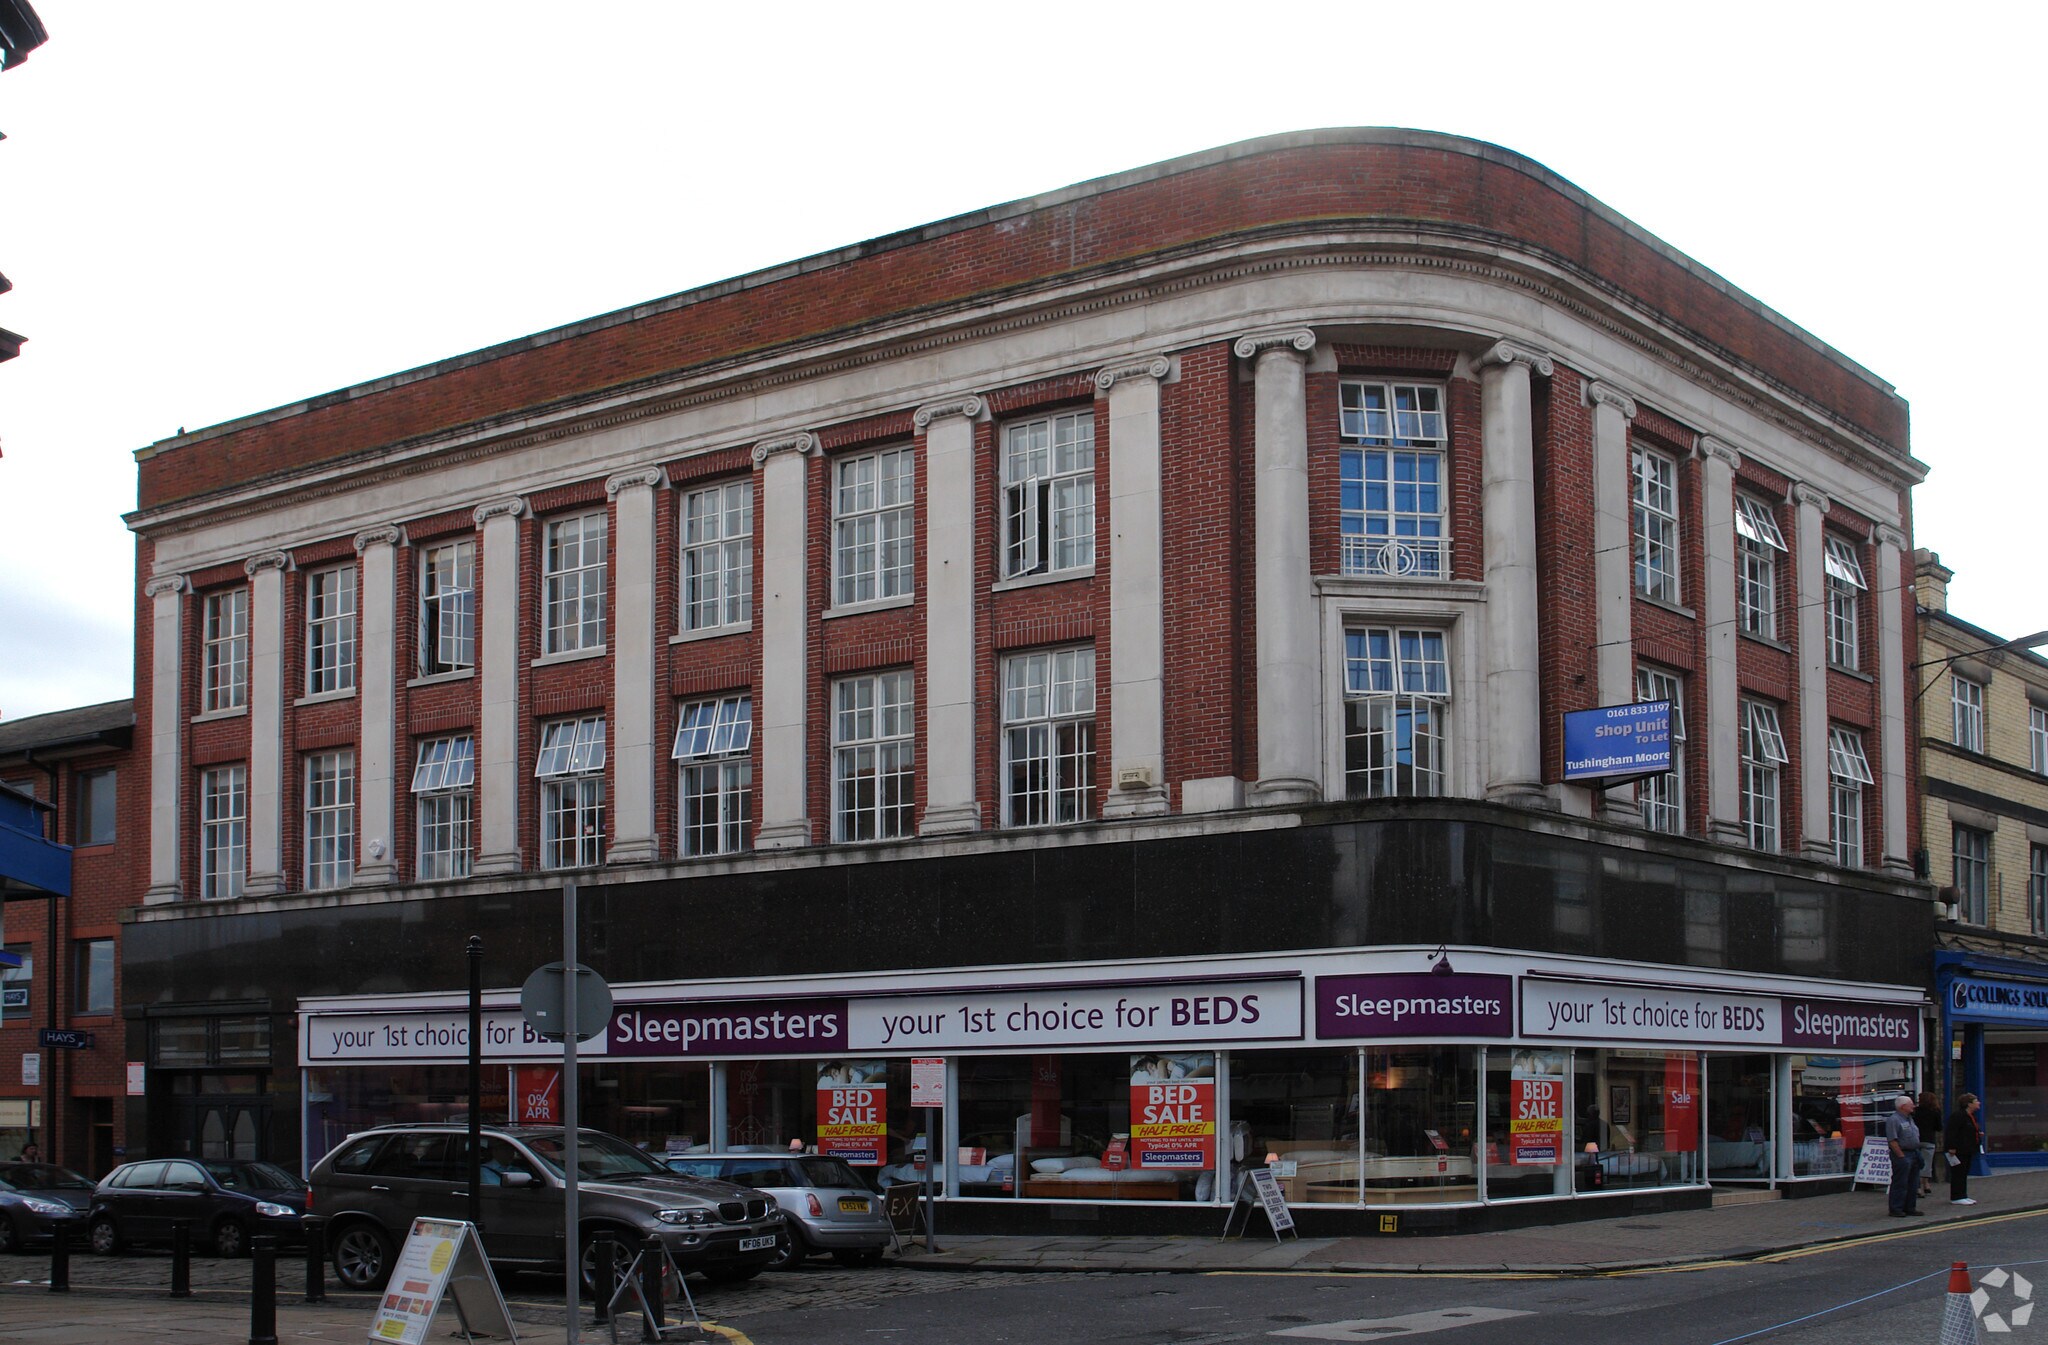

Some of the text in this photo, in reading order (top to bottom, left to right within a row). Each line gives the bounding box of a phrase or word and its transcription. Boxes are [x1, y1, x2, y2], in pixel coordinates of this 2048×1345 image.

[1607, 703, 1669, 718] 0161 833 1197
[1595, 718, 1668, 738] Shop Unit
[1635, 732, 1668, 744] To Let
[1566, 755, 1633, 770] Tushingham
[1635, 752, 1670, 763] Moore
[5, 993, 22, 1001] HAYS
[1967, 985, 2021, 1006] COLLINGS
[1335, 993, 1501, 1022] Sleepmasters
[1547, 997, 1765, 1031] your 1st choice for BEDS
[881, 994, 1260, 1044] your 1st choice for BEDS
[1794, 1003, 1909, 1045] Sleepmasters
[46, 1032, 76, 1044] HAYS
[332, 1030, 375, 1055] your
[383, 1024, 408, 1047] 1st
[415, 1022, 470, 1046] choic
[486, 1020, 516, 1044] for
[616, 1010, 838, 1052] Sleepmasters
[832, 1090, 872, 1107] BED
[1149, 1086, 1198, 1105] BED
[1522, 1081, 1553, 1100] BED
[1671, 1090, 1691, 1104] Sale
[527, 1094, 549, 1107] 0%
[526, 1107, 550, 1119] APR
[828, 1107, 878, 1125] SALE
[1143, 1105, 1203, 1124] SALE
[1518, 1101, 1556, 1120] SALE
[849, 1124, 880, 1134] PRICE!
[1169, 1123, 1207, 1136] PRICE!
[1535, 1119, 1558, 1131] PRICE!
[1145, 1153, 1200, 1162] Sleepmasters
[1519, 1148, 1554, 1158] Sleepmasters
[891, 1196, 913, 1216] EX
[1382, 1216, 1396, 1231] H
[743, 1236, 774, 1249] MF06 UKS
